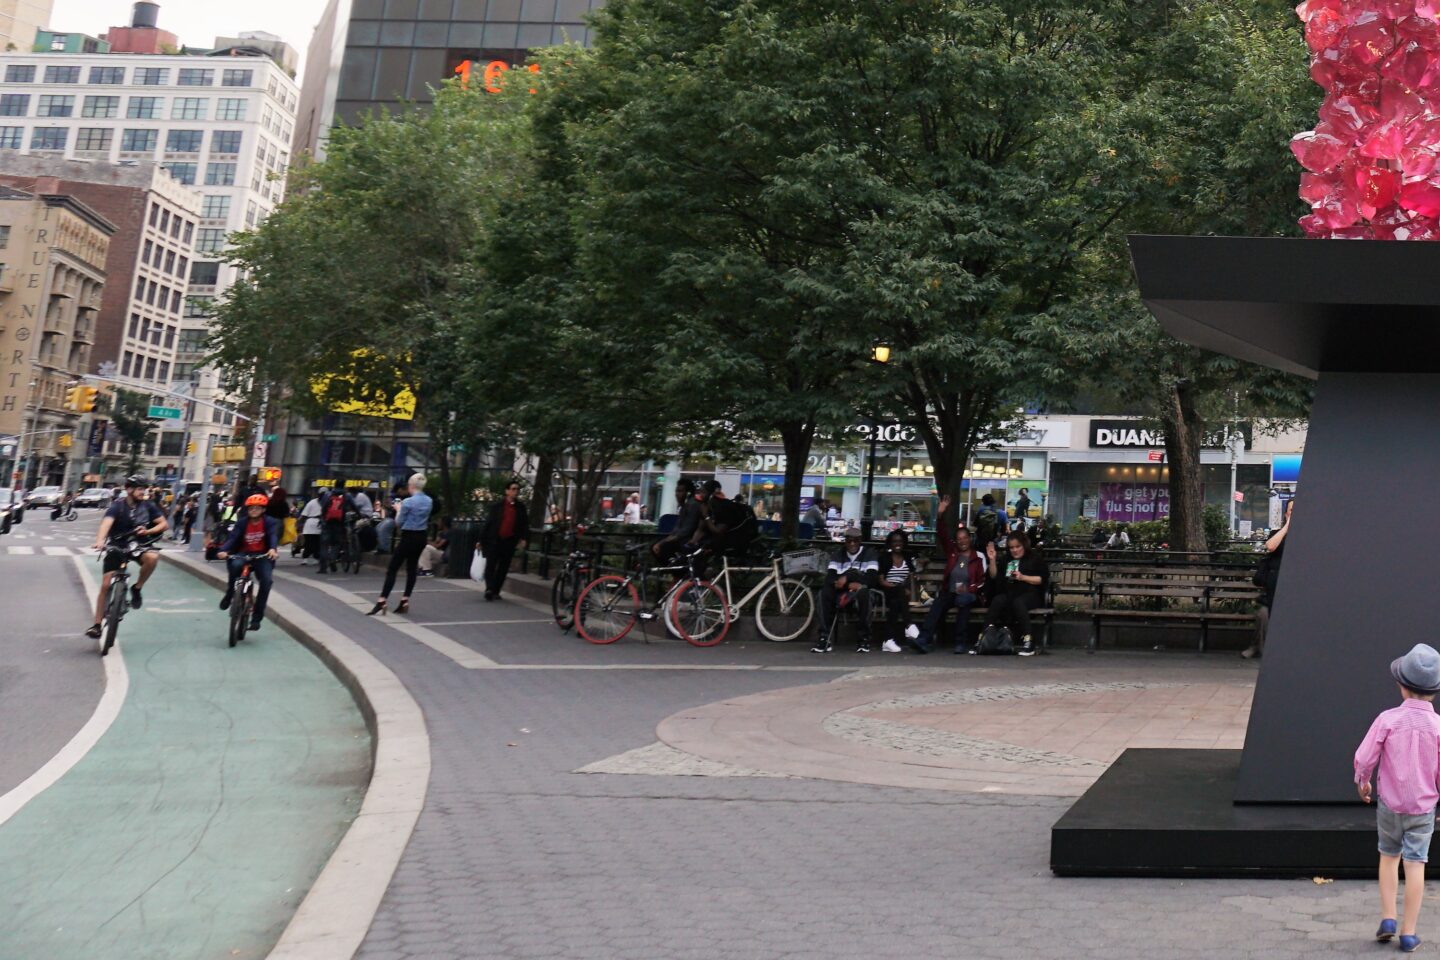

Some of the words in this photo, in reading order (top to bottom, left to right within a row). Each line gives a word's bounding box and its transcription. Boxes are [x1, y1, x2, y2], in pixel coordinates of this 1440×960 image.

[1124, 487, 1149, 501] get
[1106, 500, 1122, 513] flu
[1125, 500, 1155, 513] shot
